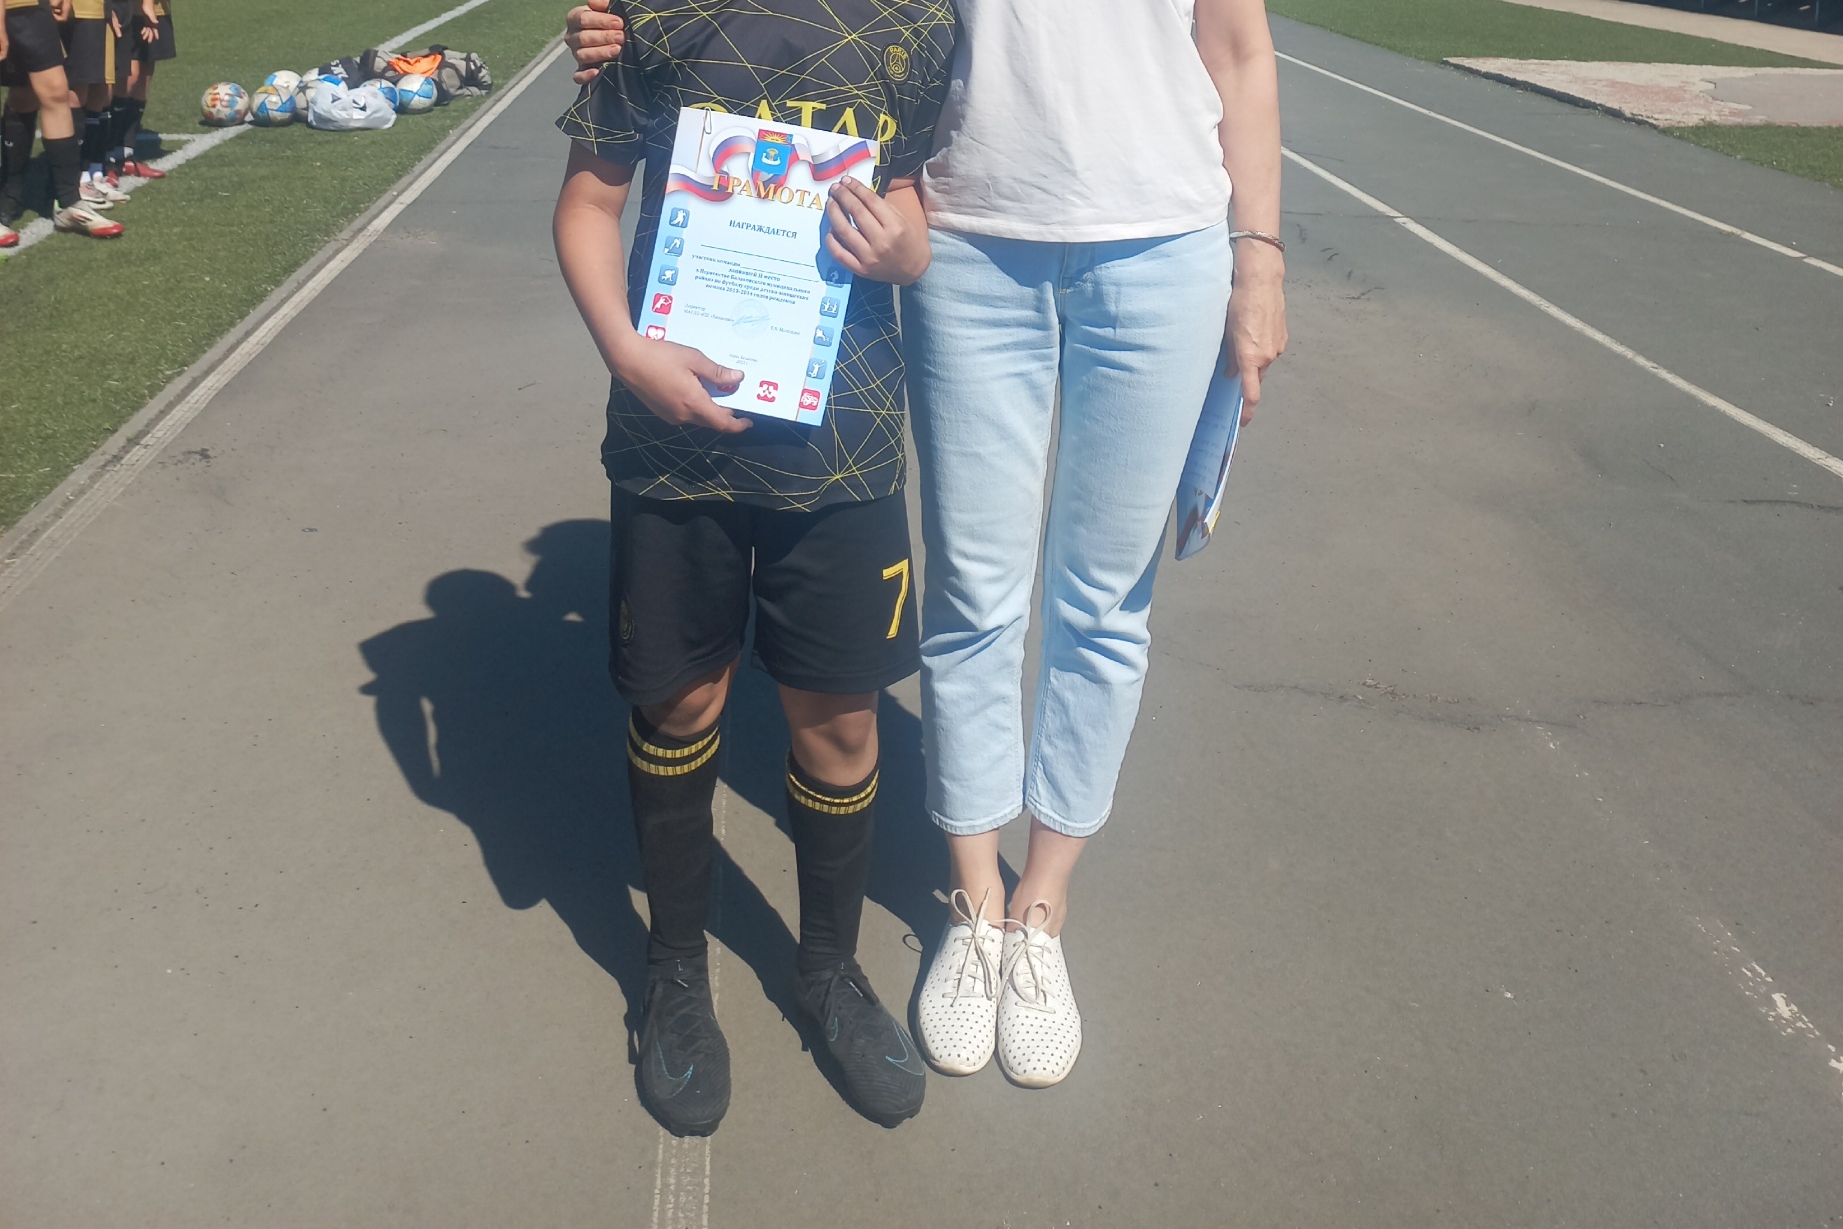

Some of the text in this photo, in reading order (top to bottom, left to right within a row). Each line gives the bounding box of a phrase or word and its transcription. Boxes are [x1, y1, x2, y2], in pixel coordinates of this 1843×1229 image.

[711, 172, 824, 211] ГРАМОТА
[729, 219, 797, 239] НАГРАЖДАЕТСЯ
[882, 557, 910, 640] 7
